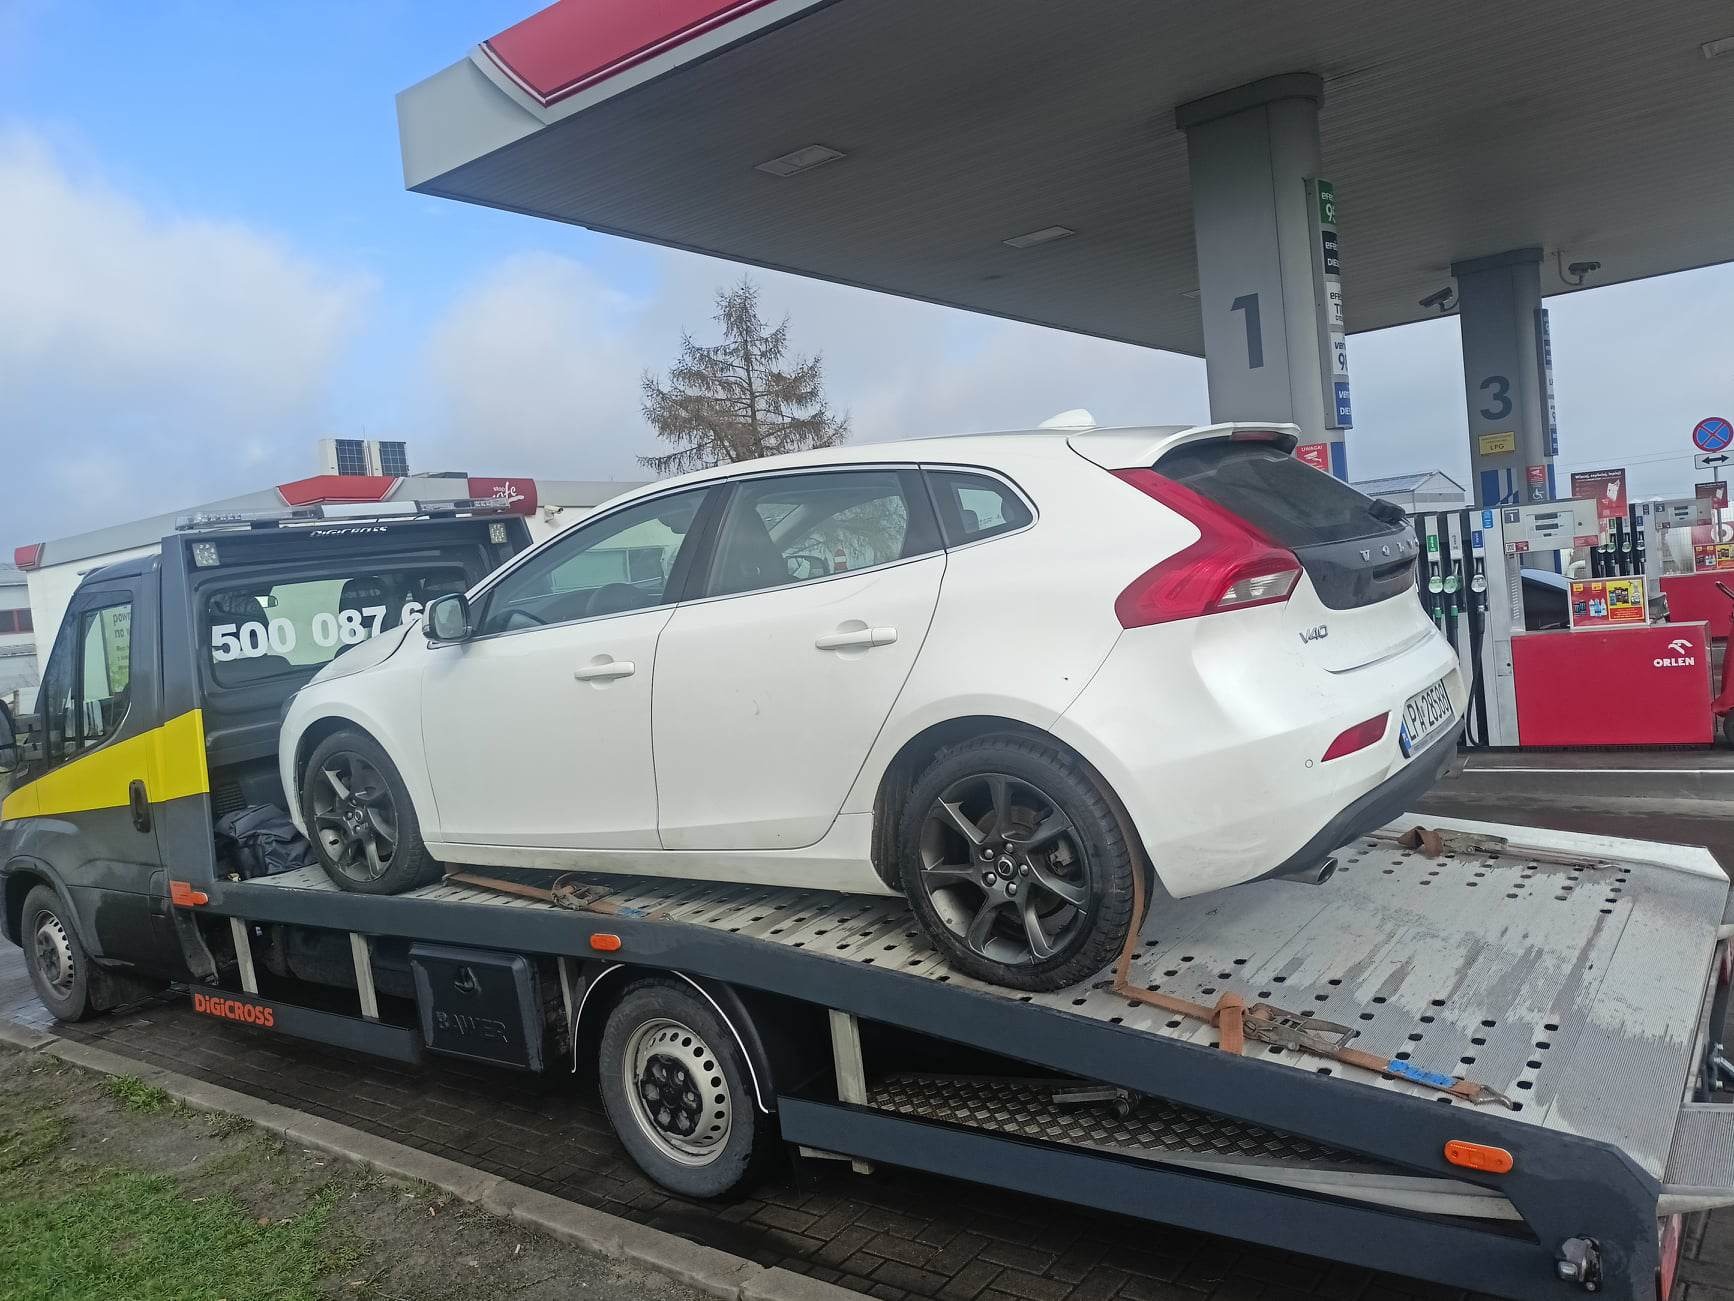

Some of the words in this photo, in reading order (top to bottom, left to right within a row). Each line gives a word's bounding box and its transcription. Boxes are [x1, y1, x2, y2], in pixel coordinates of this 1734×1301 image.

[1231, 293, 1264, 370] 1
[1480, 375, 1512, 420] 3
[212, 618, 296, 662] 500
[312, 606, 386, 647] 087
[402, 600, 432, 624] 6
[1299, 624, 1328, 644] V40
[1654, 657, 1694, 667] ORLEN
[1403, 700, 1427, 740] LPA
